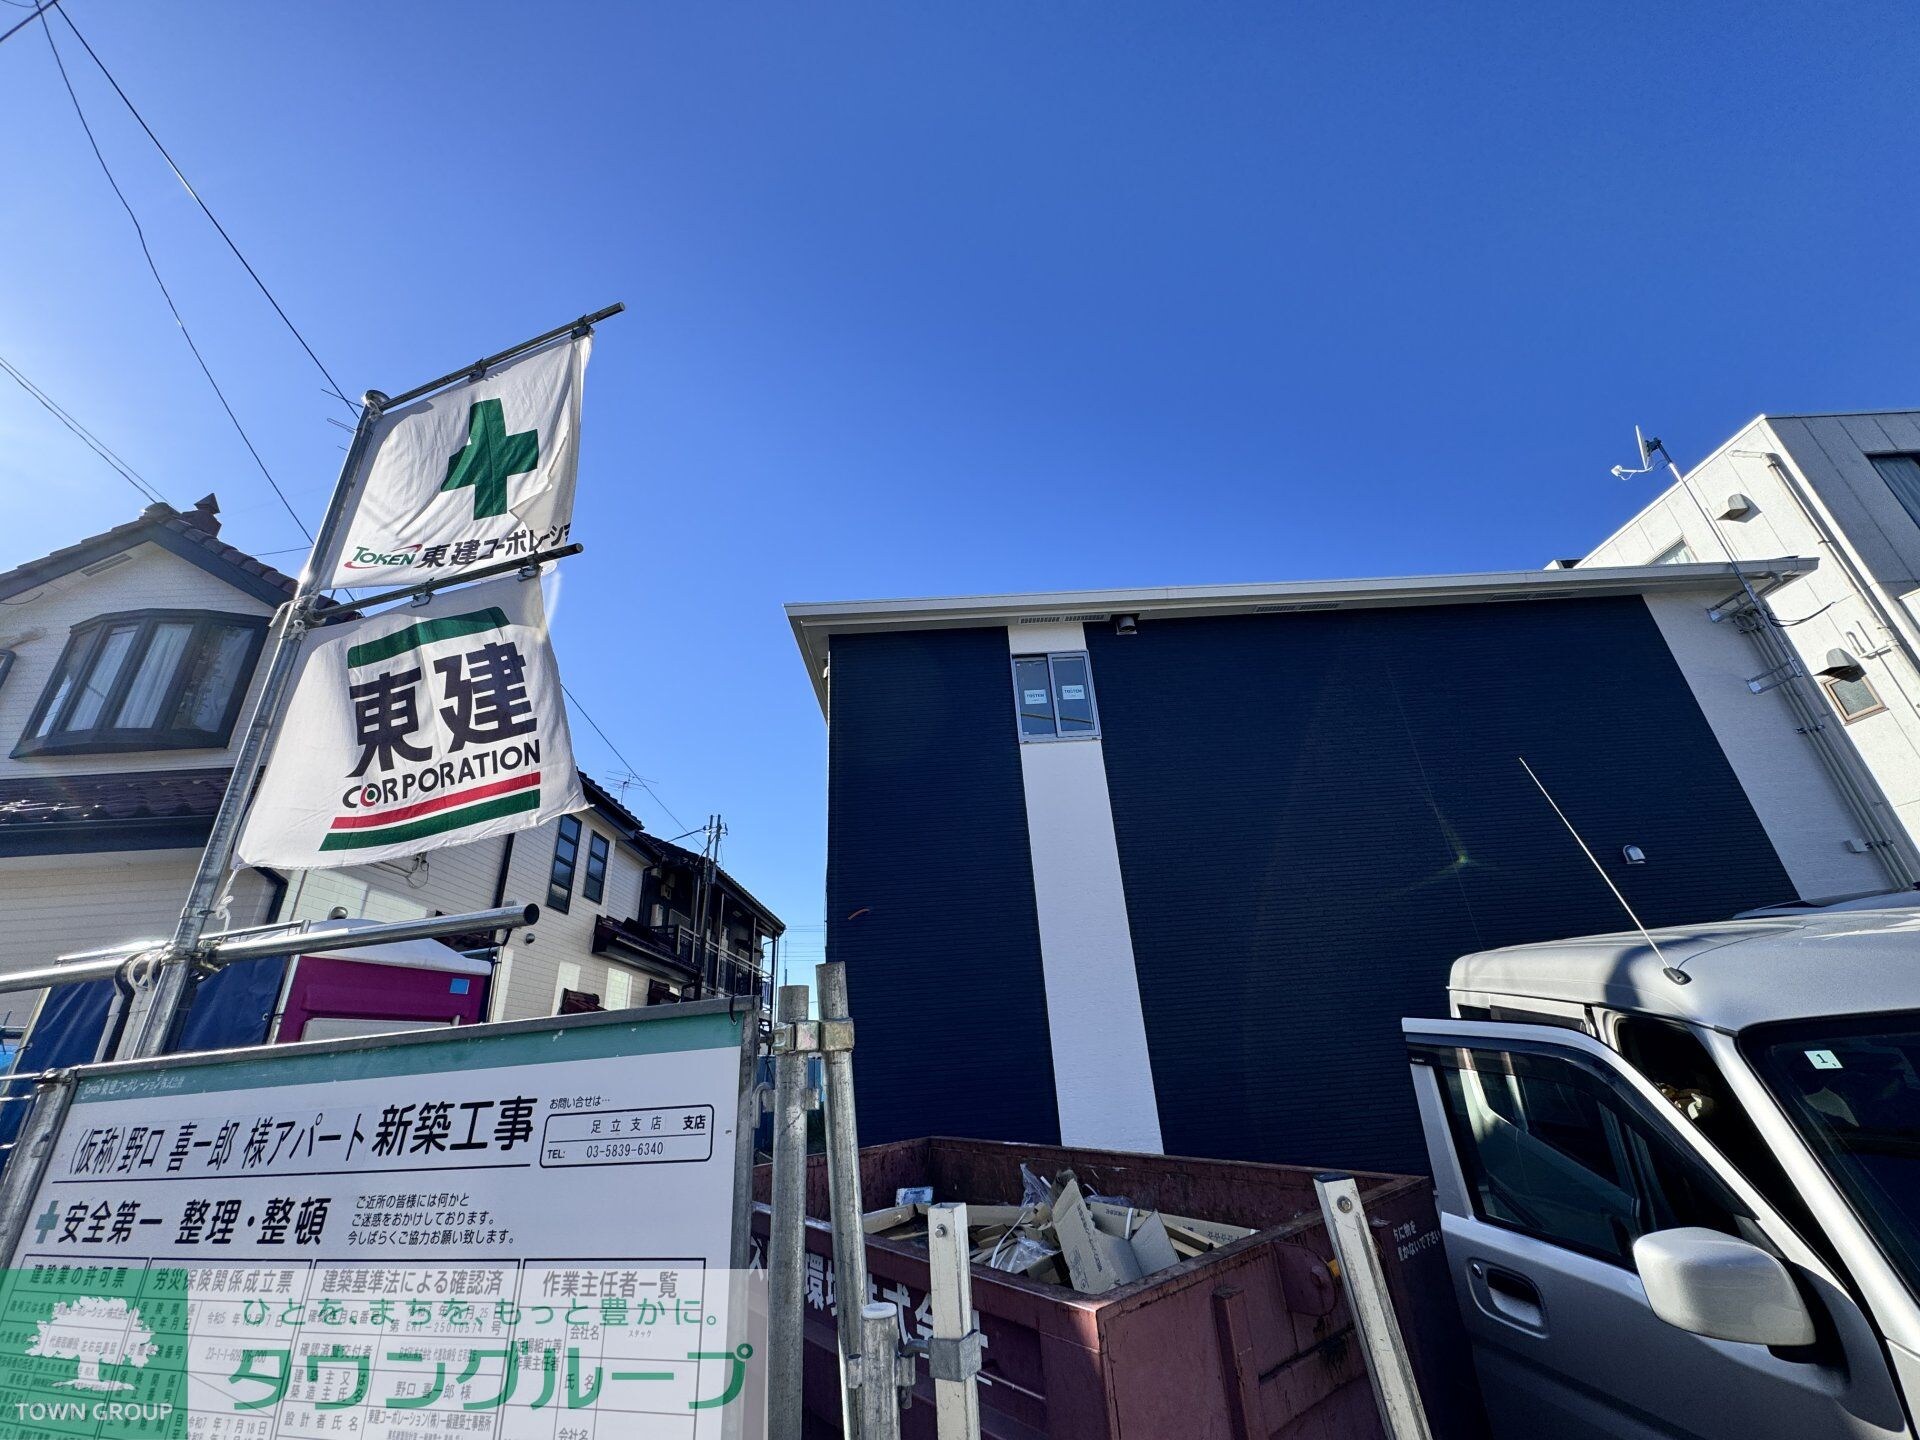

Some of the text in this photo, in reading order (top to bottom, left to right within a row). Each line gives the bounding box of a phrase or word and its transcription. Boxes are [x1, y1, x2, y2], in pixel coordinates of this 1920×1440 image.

[351, 546, 416, 566] TOKEN
[344, 641, 538, 778] 東建
[342, 739, 540, 808] CORPORATION
[683, 1114, 706, 1131] 支店
[586, 1141, 664, 1159] 03-5839-6340
[356, 1192, 470, 1209] ご近所の皆様には何かと
[58, 1197, 332, 1245] 安全第一 整理・整頓
[352, 1210, 495, 1227] ご迷惑をおかけしております。
[347, 1228, 514, 1246] 今しばらくご協力お願い致します。
[153, 1268, 295, 1294] 労災保険関係成立票
[321, 1269, 504, 1296] 建築基準法による確認済
[542, 1270, 678, 1299] 作業主任者一覧
[569, 1325, 600, 1340] 会社名
